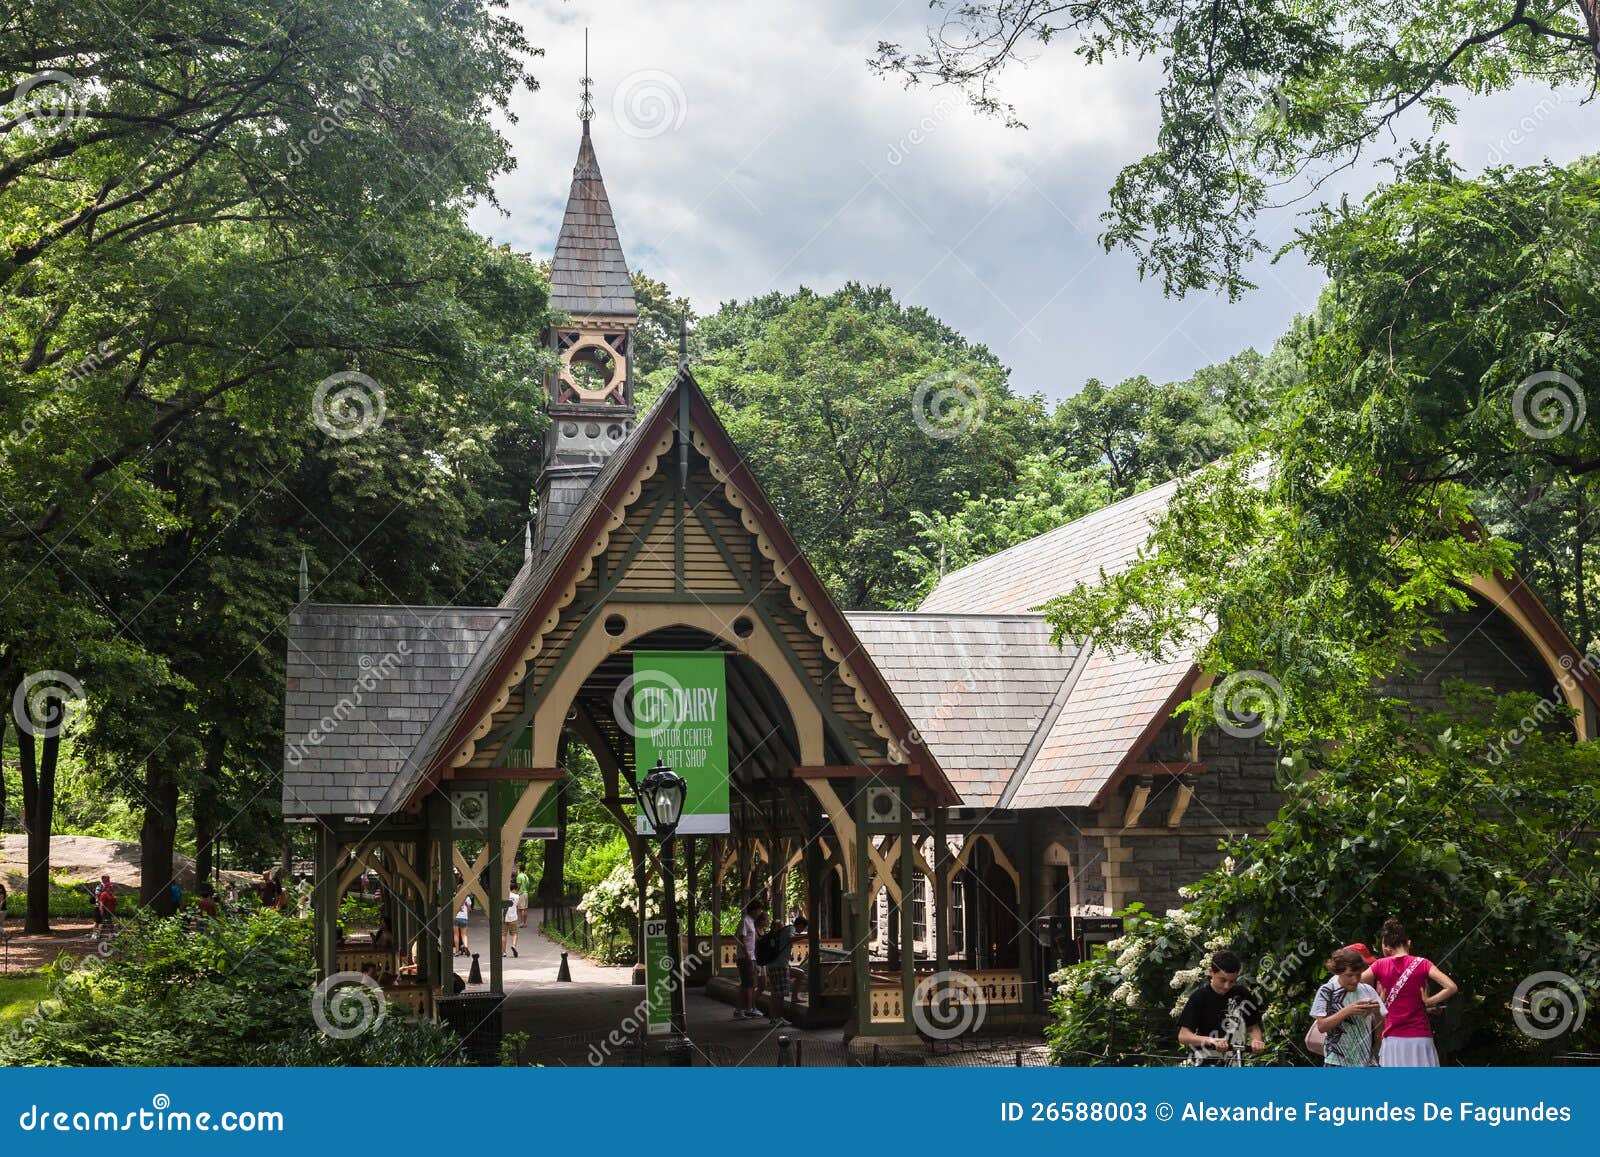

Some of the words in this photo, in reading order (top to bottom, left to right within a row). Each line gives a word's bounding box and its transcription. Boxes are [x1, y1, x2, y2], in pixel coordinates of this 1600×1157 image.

[642, 688, 670, 723] THE
[673, 688, 718, 722] DAIRY
[651, 728, 681, 748] VISITOR
[684, 728, 713, 747] CENTER
[667, 749, 683, 768] GIFT
[685, 749, 707, 768] SHOP
